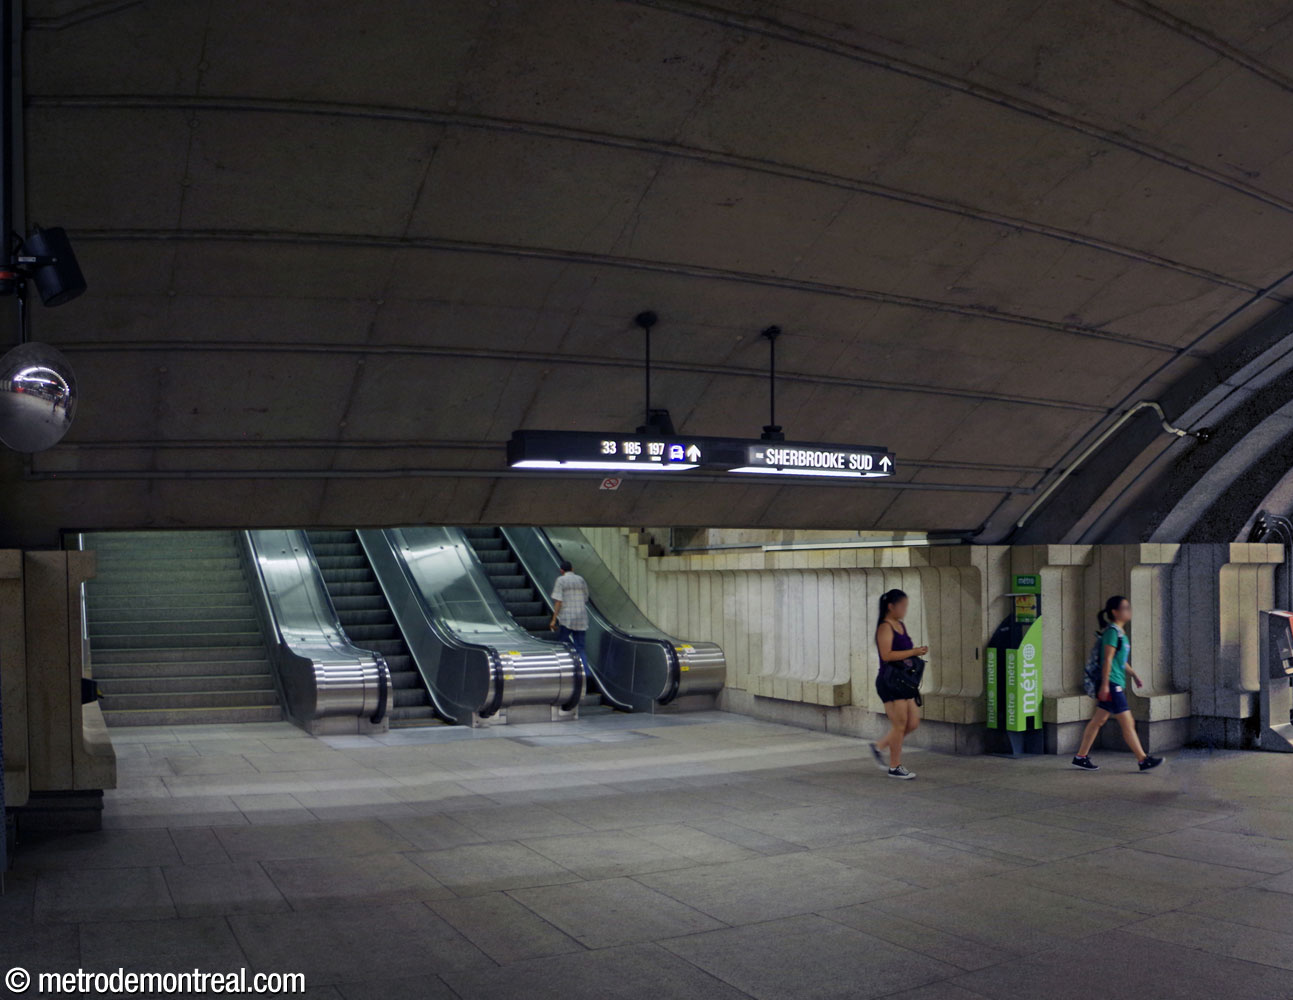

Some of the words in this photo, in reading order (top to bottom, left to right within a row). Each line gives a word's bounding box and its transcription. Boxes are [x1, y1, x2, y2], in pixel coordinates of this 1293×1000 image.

[602, 441, 617, 454] 33
[623, 441, 642, 455] 185
[648, 442, 665, 456] 197
[766, 448, 845, 469] SHERBROOKE
[848, 454, 873, 470] SUD
[1020, 643, 1036, 714] métro
